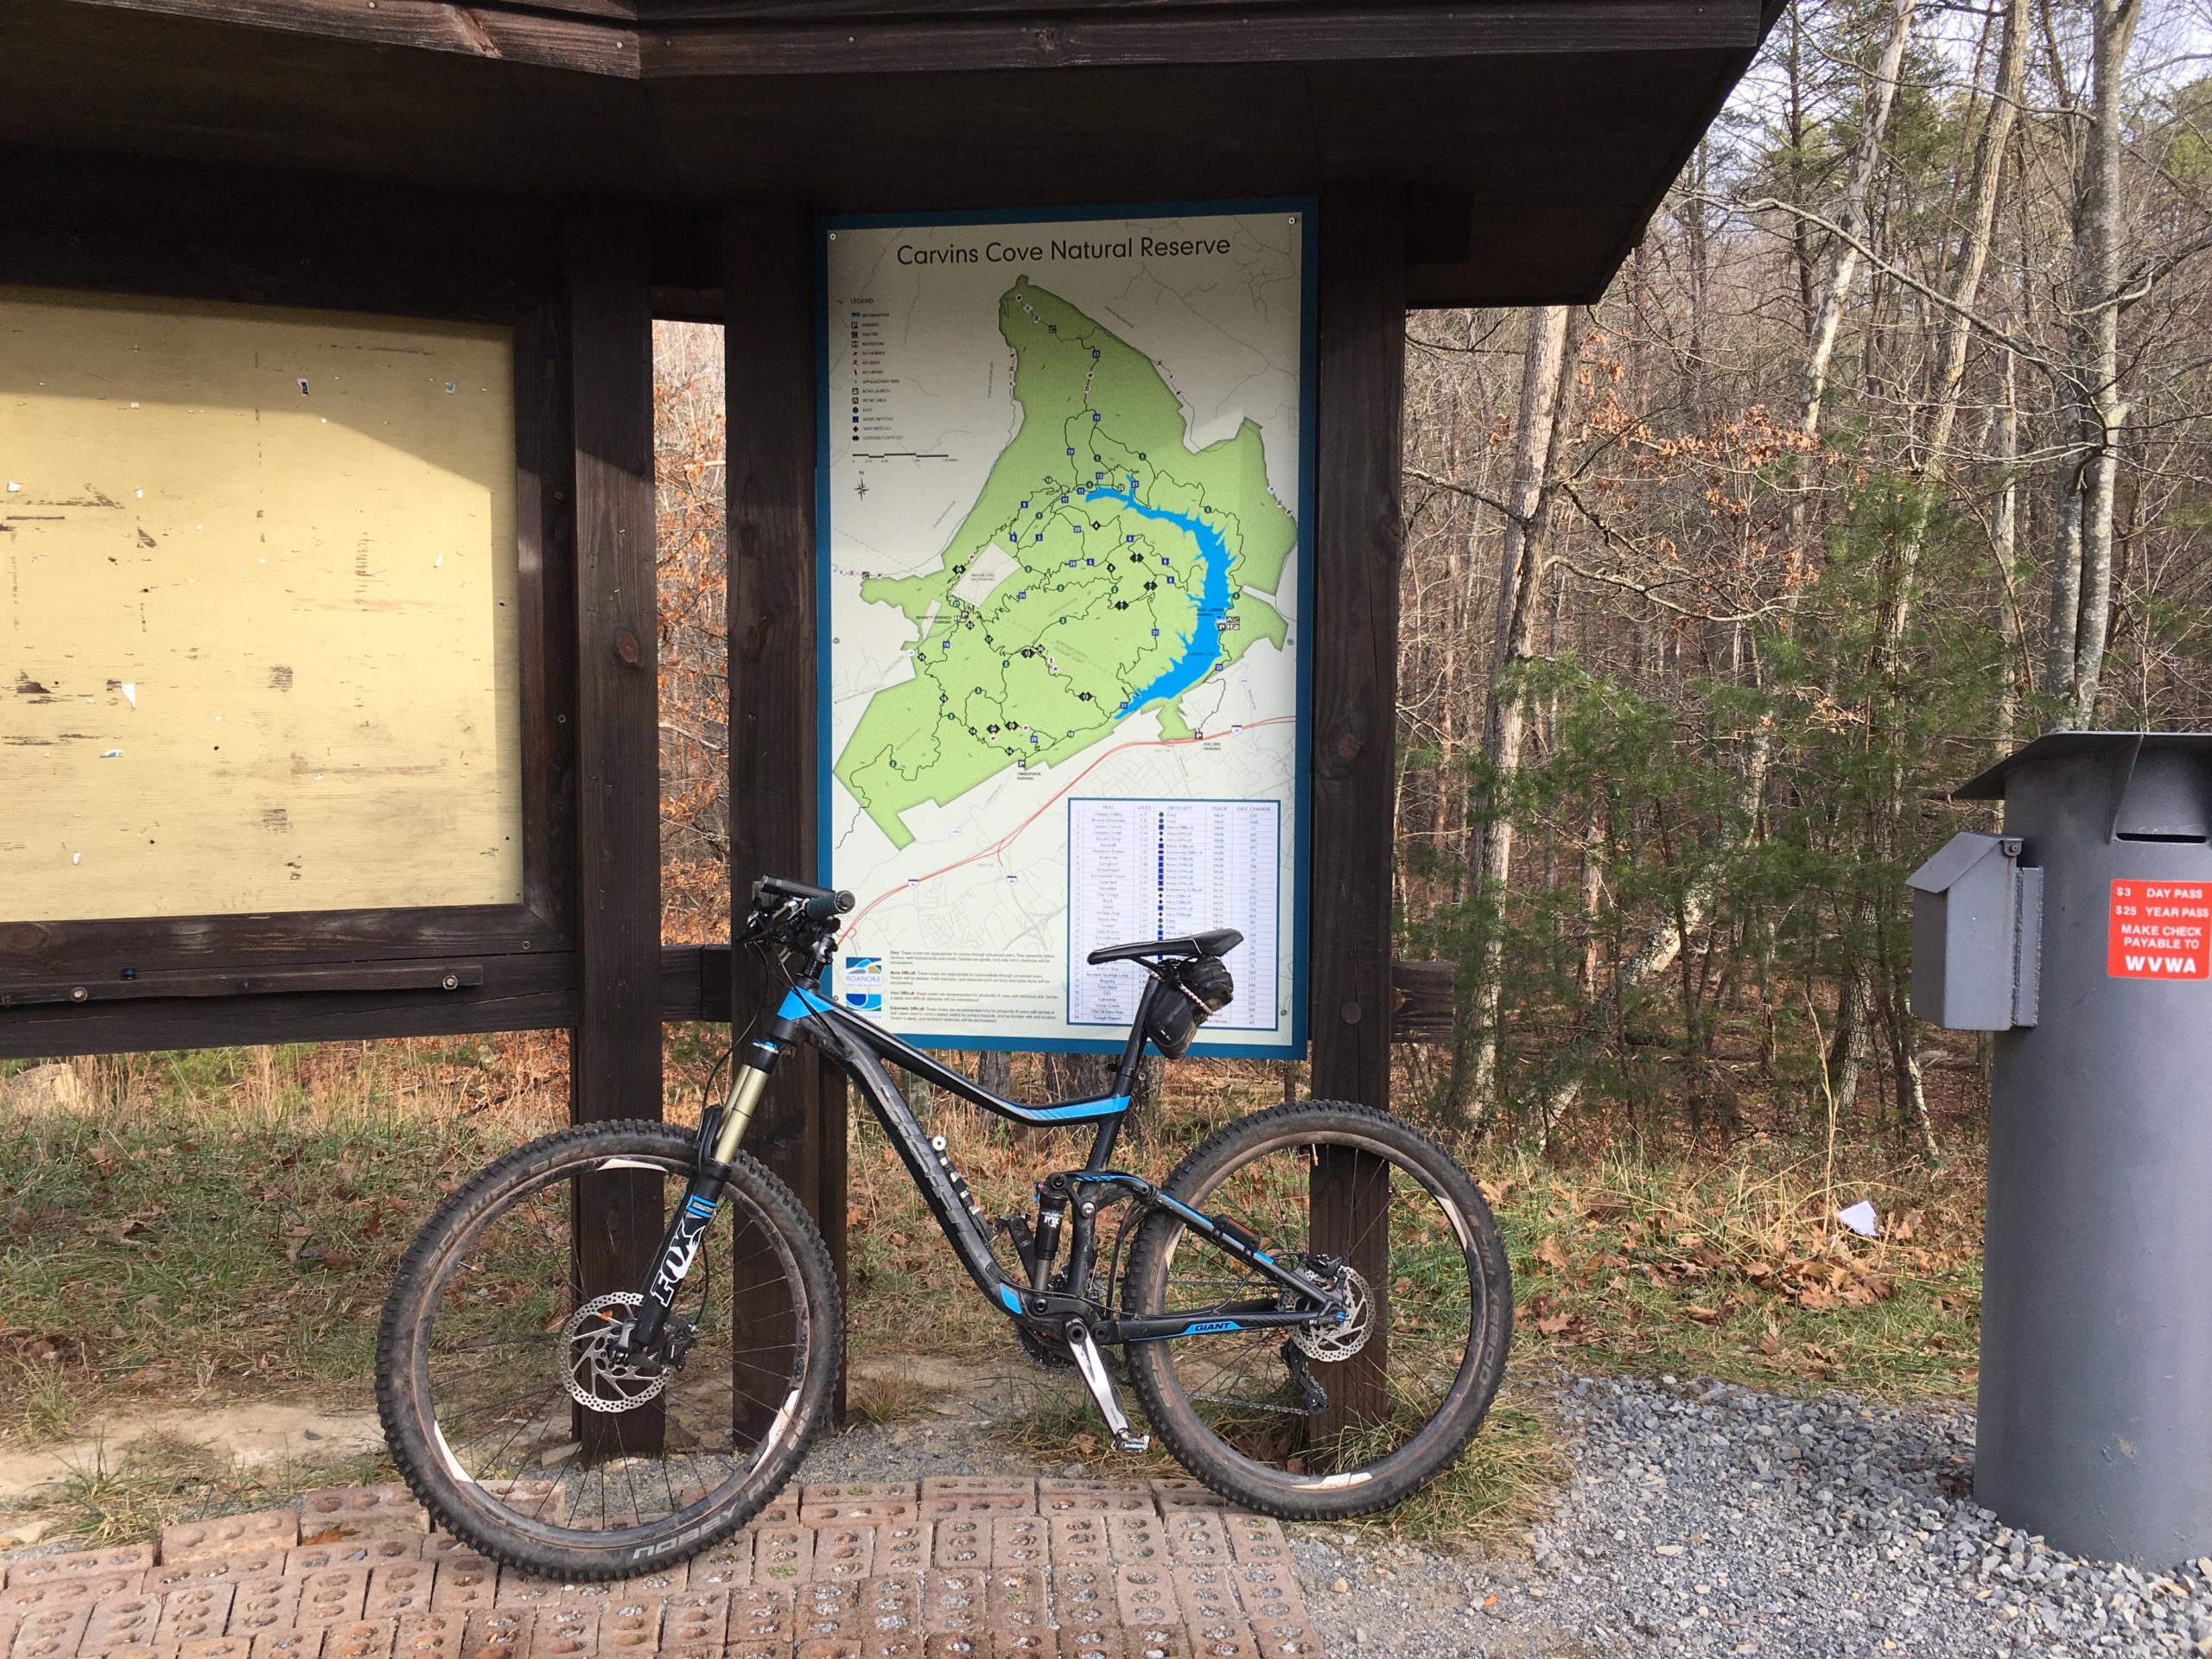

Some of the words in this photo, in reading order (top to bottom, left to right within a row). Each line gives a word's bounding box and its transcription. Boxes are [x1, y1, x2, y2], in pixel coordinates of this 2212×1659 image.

[897, 244, 978, 265] Carvins
[986, 242, 1043, 263] Cove
[1051, 238, 1132, 260] Natural
[1141, 237, 1230, 257] Reserve
[2116, 887, 2131, 896] $3
[2146, 888, 2171, 898] DAY
[2174, 889, 2203, 899] PASS
[2115, 906, 2137, 916] $25
[2145, 907, 2179, 917] YEAR
[2182, 908, 2209, 918] PASS
[2121, 925, 2159, 935] MAKE
[2162, 926, 2202, 937] CHECK
[2124, 938, 2181, 949] PAYABLE
[2184, 939, 2199, 949] TO
[2125, 955, 2196, 973] WVWA
[1044, 1215, 1060, 1228] FOX
[650, 1217, 706, 1307] FOX
[1195, 1322, 1231, 1332] GIANT
